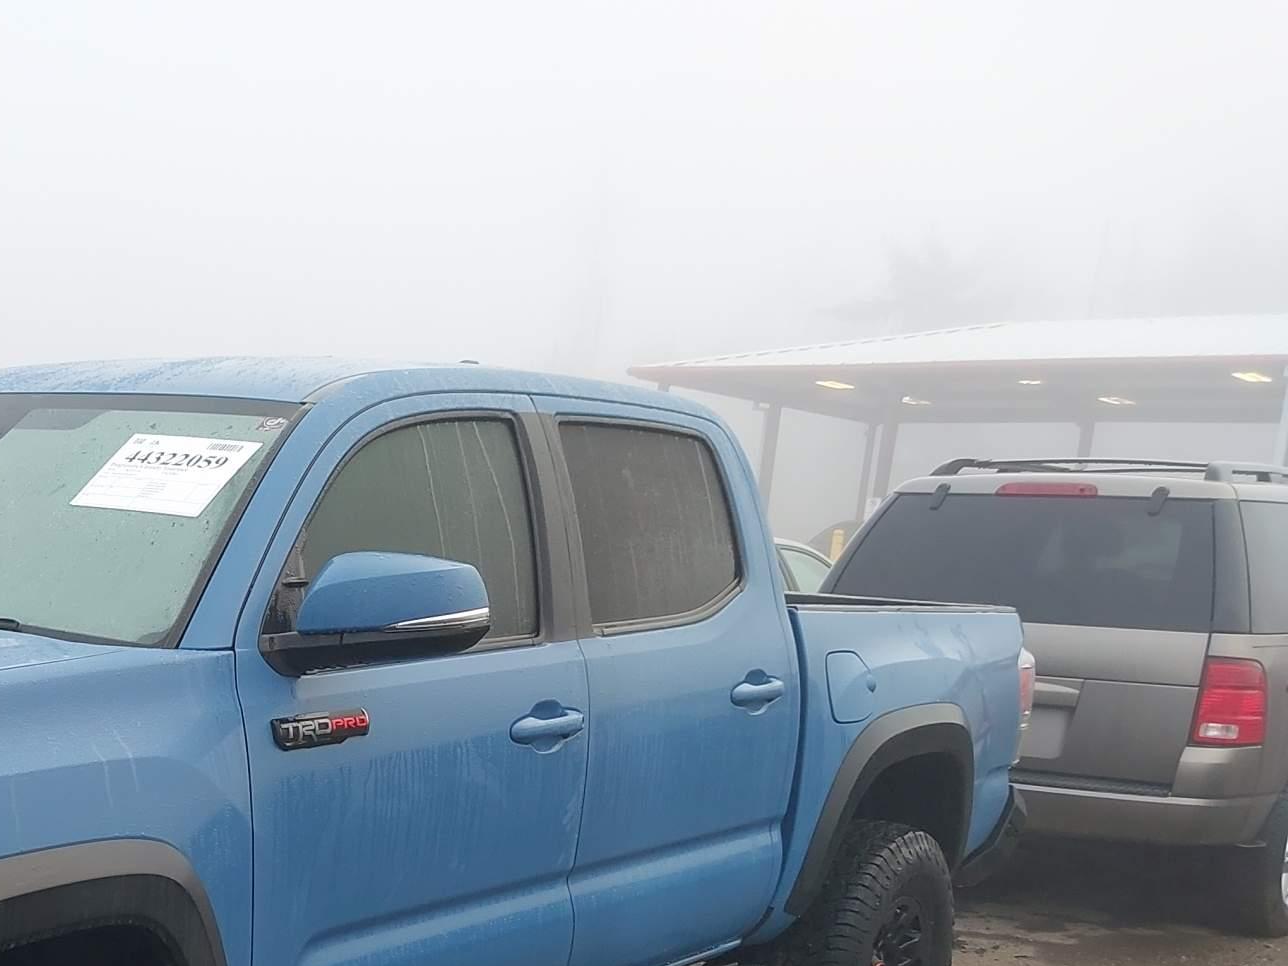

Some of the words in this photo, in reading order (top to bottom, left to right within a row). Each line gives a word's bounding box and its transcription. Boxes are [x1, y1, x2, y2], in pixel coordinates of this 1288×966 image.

[124, 450, 229, 470] 44322059
[280, 719, 332, 742] TRD
[332, 715, 369, 730] PRO
